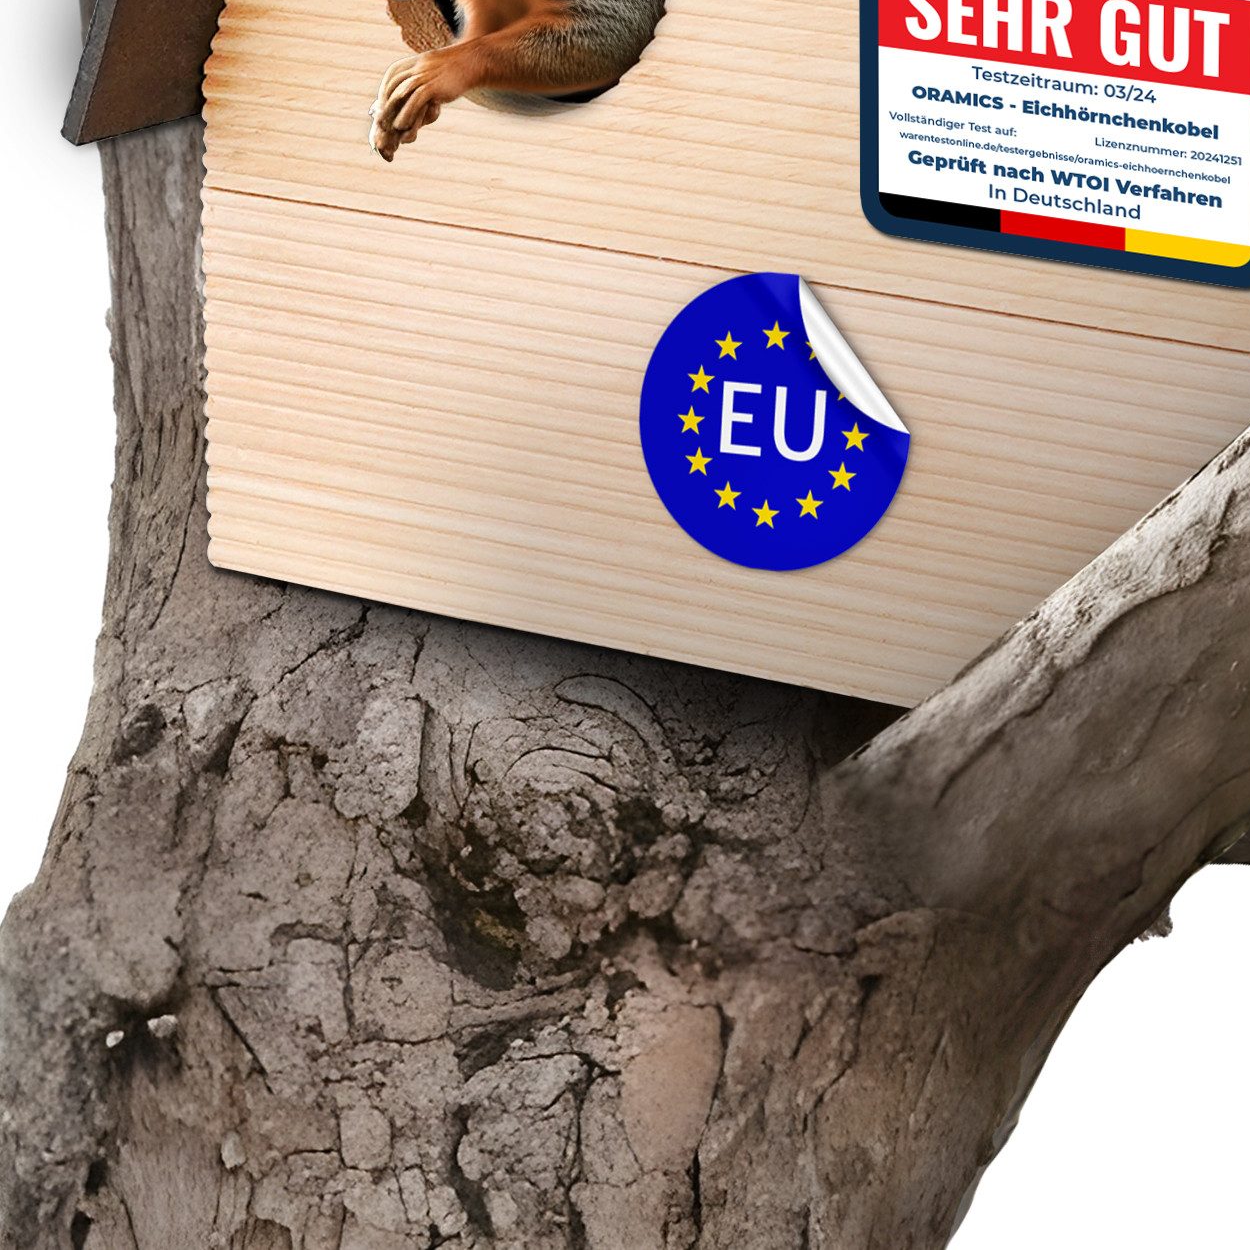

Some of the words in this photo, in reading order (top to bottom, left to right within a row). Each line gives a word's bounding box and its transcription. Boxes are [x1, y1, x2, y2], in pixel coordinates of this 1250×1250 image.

[1101, 0, 1230, 77] GUT
[972, 66, 1098, 96] Testzeitraum:
[1104, 84, 1156, 104] 03/24
[889, 112, 964, 131] Vollständiger
[968, 122, 992, 134] Test
[995, 125, 1016, 137] auf:
[912, 86, 1003, 110] ORAMICS
[1023, 100, 1219, 140] Eichhörnchenkobel
[1095, 137, 1187, 158] Lizenznummer:
[1191, 150, 1242, 166] 20241251
[908, 151, 986, 175] Geprüft
[993, 163, 1044, 183] nach
[1051, 170, 1109, 192] WTOI
[1116, 180, 1222, 208] Verfahren
[989, 184, 1006, 201] In
[1014, 188, 1140, 220] Deutschland
[720, 381, 827, 462] EU
